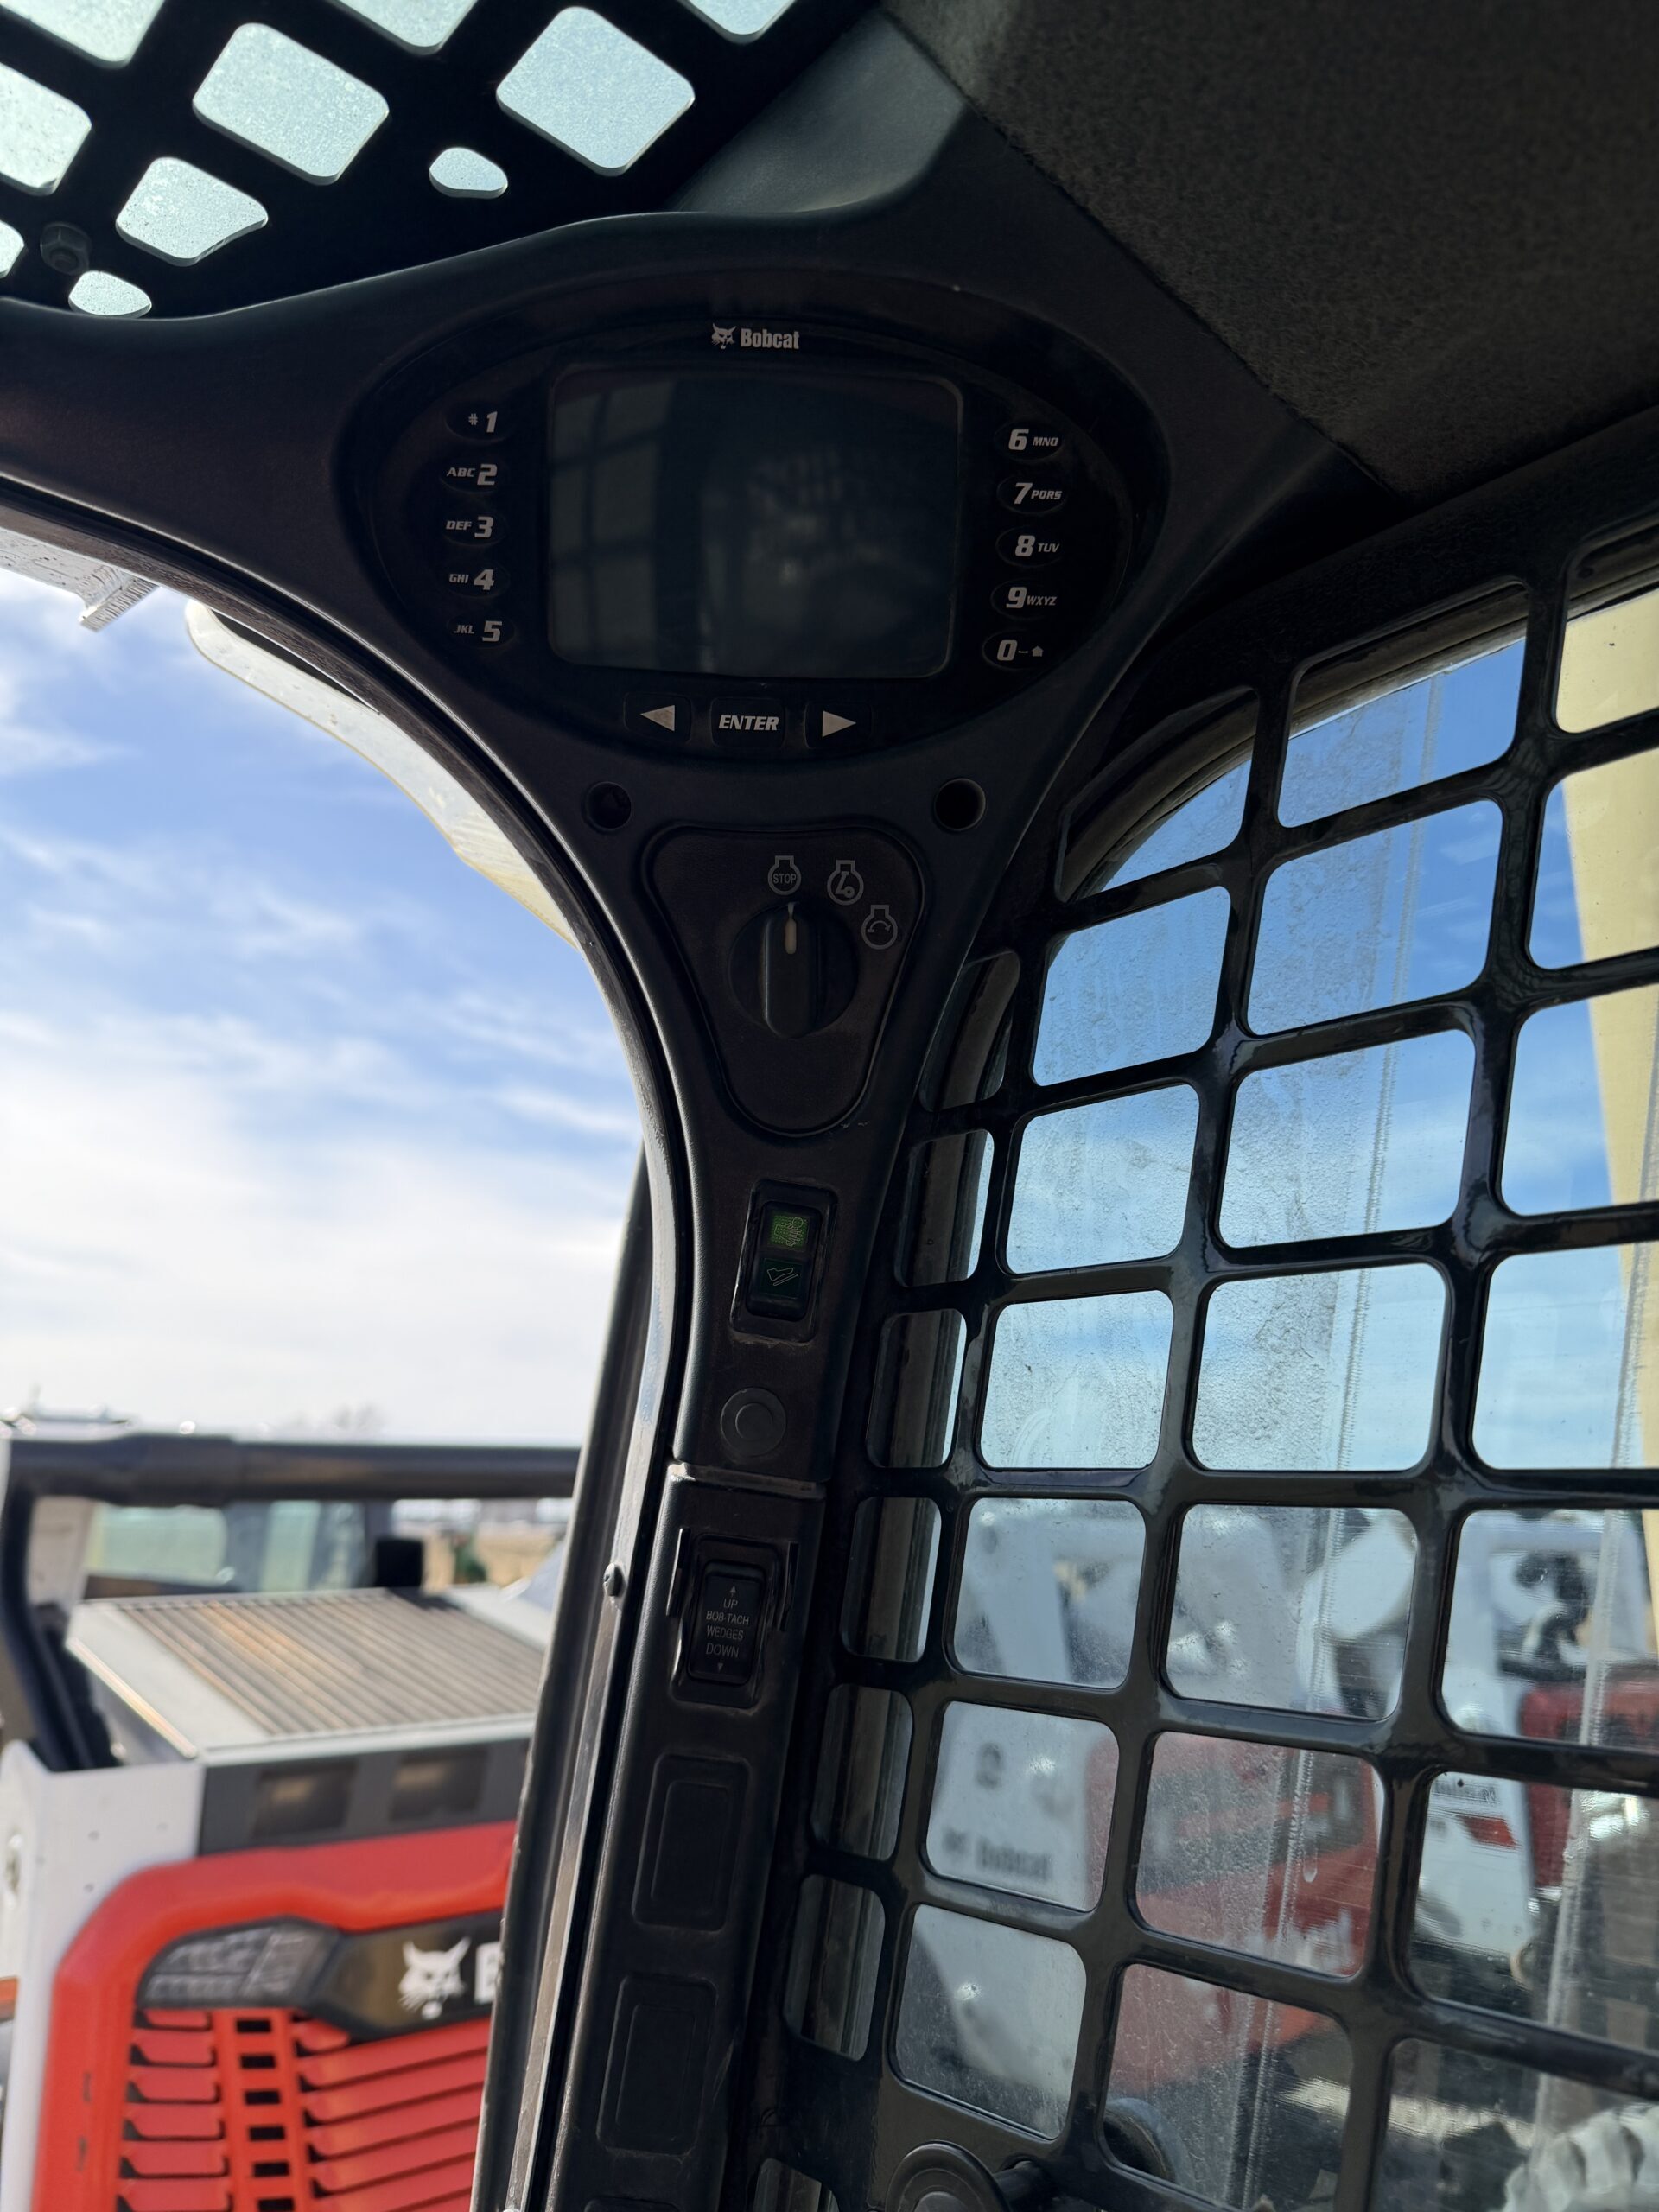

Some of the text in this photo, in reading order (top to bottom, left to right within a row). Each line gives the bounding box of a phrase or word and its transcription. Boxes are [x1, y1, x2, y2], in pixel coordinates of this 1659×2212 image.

[740, 327, 800, 350] Bobcat
[486, 410, 499, 433] 1
[1008, 429, 1029, 451] 6
[446, 463, 498, 486] ABC 2
[1014, 482, 1033, 505] 7
[445, 516, 494, 538] DEF 3
[1014, 535, 1060, 557] 8 TUV
[448, 569, 495, 591] GHI 4
[1006, 587, 1058, 609] 9 WXYZ
[453, 620, 503, 642] JKL 5
[718, 714, 779, 732] ENTER
[772, 873, 797, 885] STOP
[723, 1598, 739, 1609] UP
[705, 1610, 749, 1626] BOB-TACH
[706, 1624, 744, 1641] WEDGES
[705, 1642, 740, 1658] DOWN
